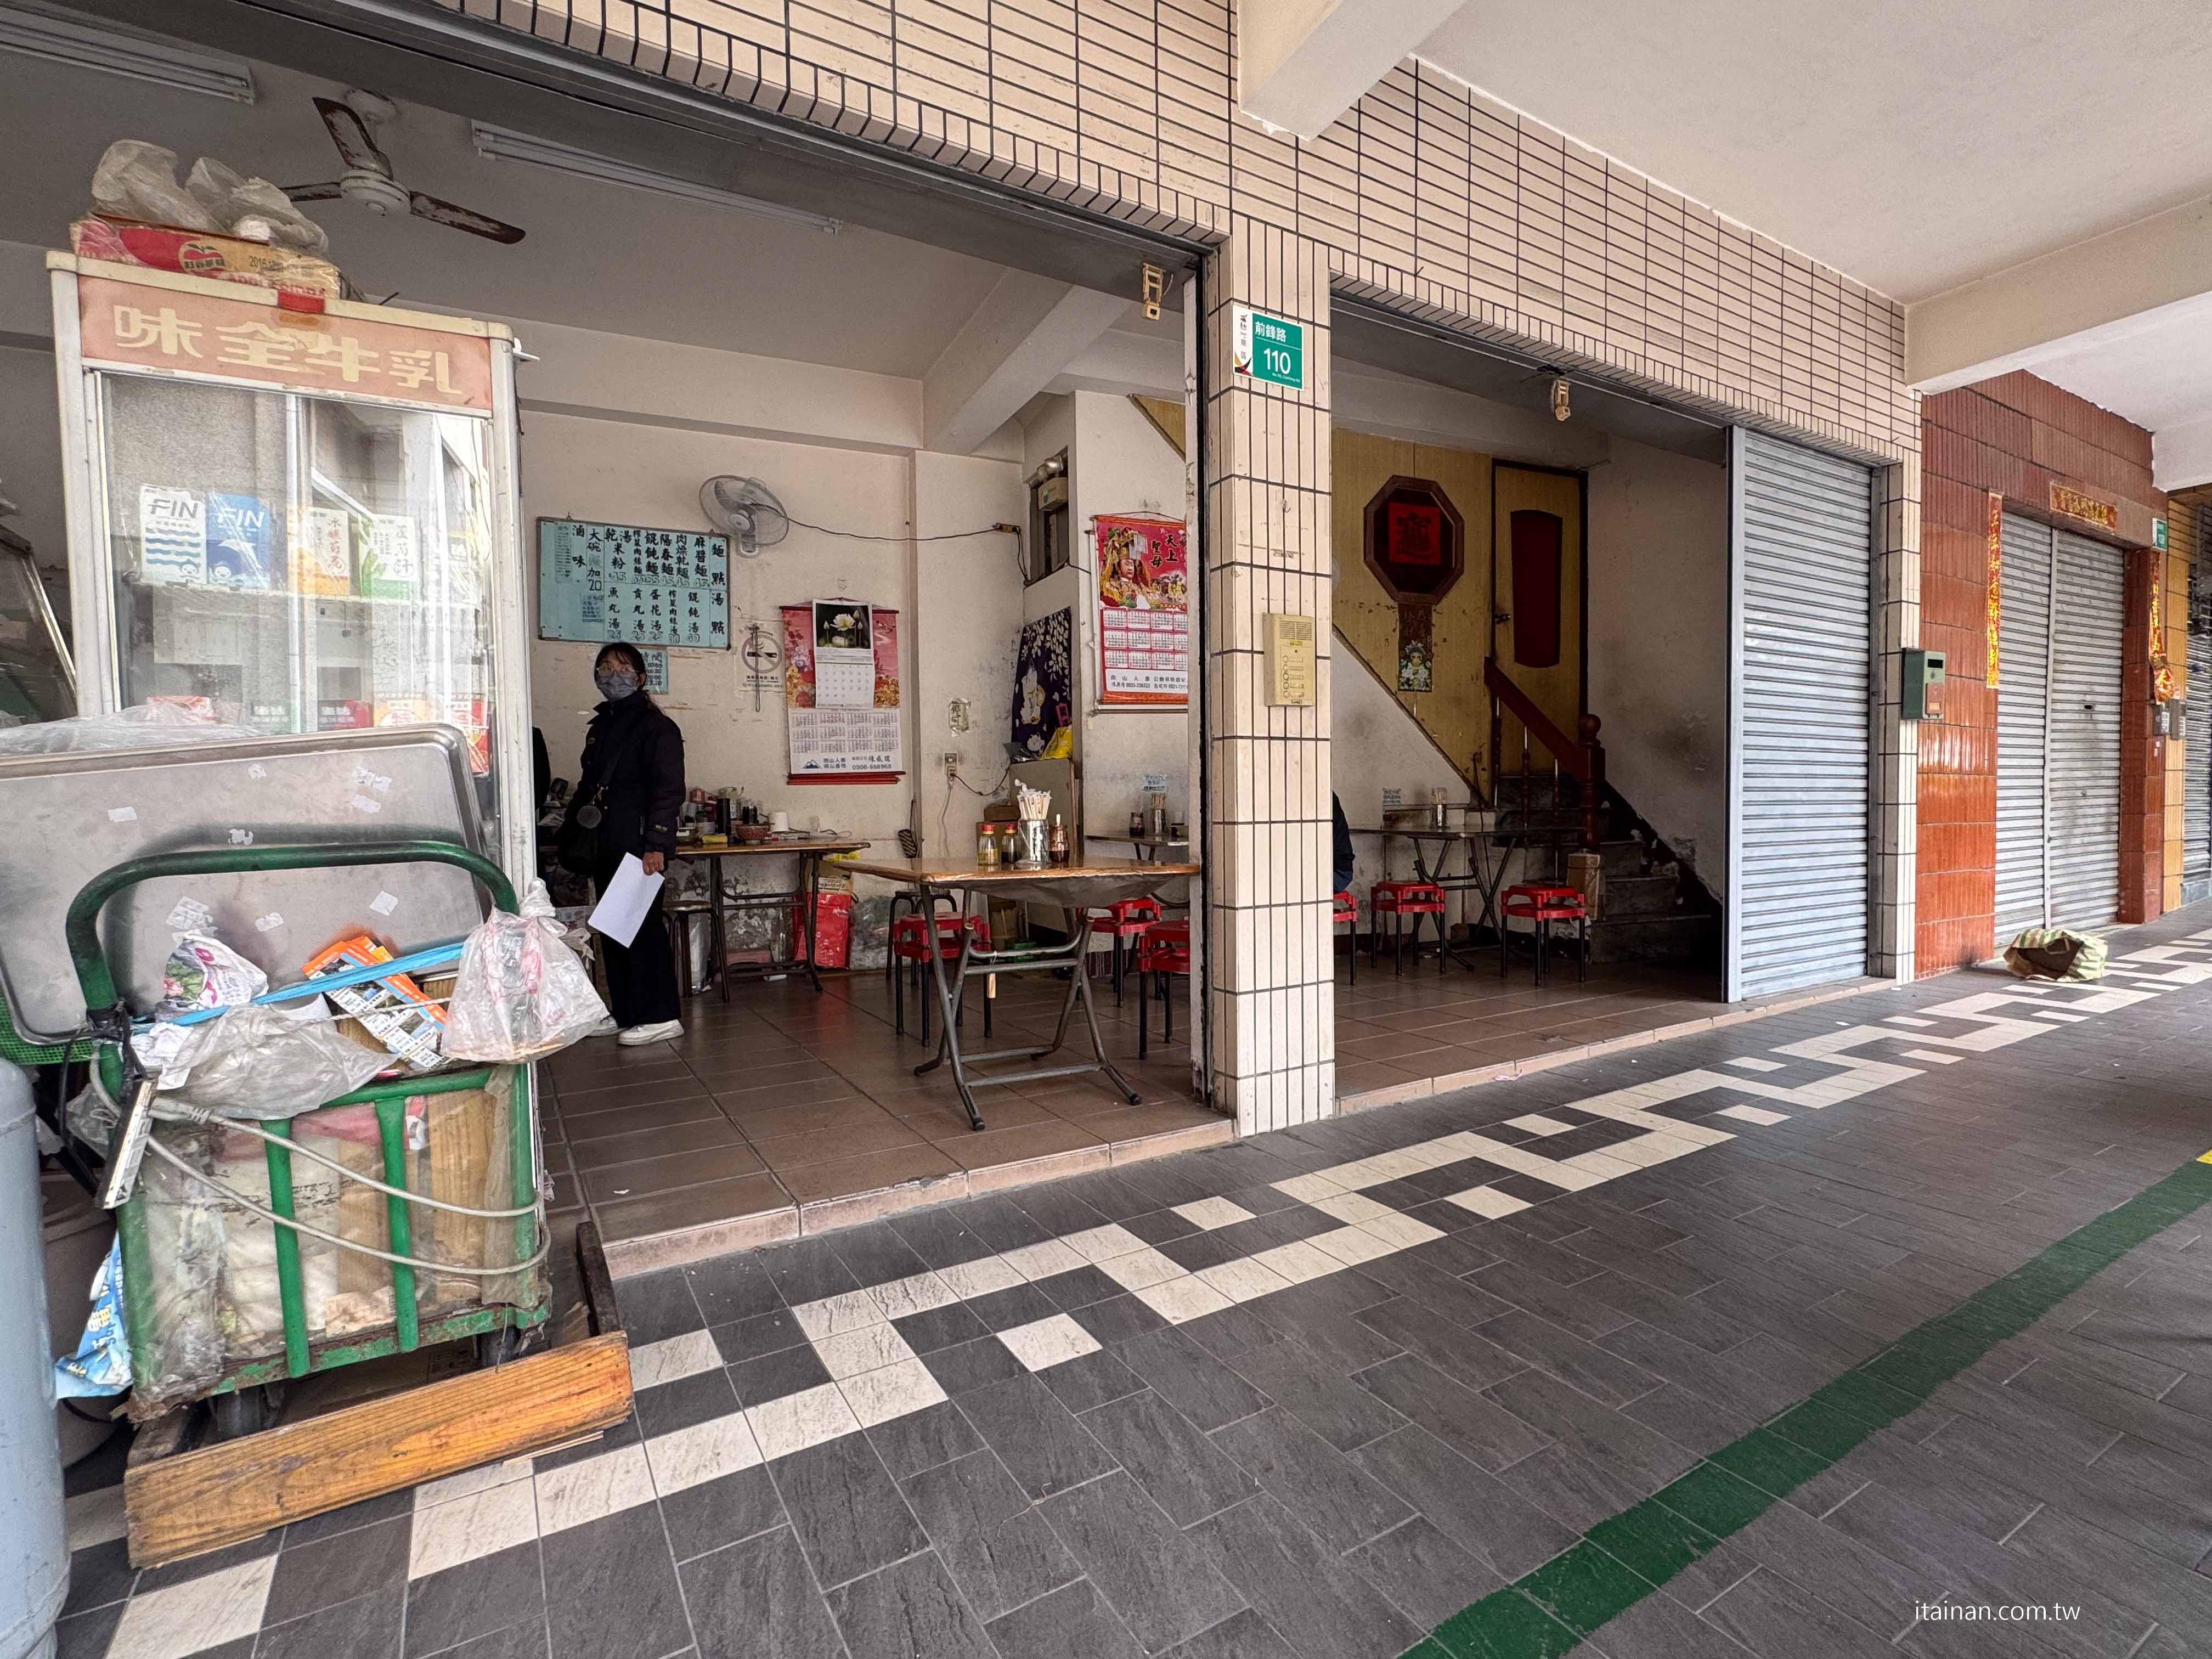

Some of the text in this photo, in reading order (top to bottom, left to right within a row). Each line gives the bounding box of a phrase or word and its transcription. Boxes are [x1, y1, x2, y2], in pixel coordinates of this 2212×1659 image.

[113, 305, 464, 395] 味全牛乳
[1255, 321, 1286, 343] 前鋒路
[1263, 347, 1291, 375] 110
[148, 498, 198, 519] FIN
[215, 507, 264, 528] FIN
[587, 528, 603, 578] 大碗加
[645, 531, 659, 575] 餛飩麵
[661, 534, 675, 575] 陽春麵
[694, 537, 709, 578] 麻醬麵
[1150, 534, 1178, 568] 天上 聖母
[588, 579, 602, 591] 20
[607, 587, 620, 629] 魚丸湯
[632, 588, 645, 631] 貢丸湯
[650, 588, 662, 631] 蛋花湯
[687, 591, 700, 633] 餛飩湯
